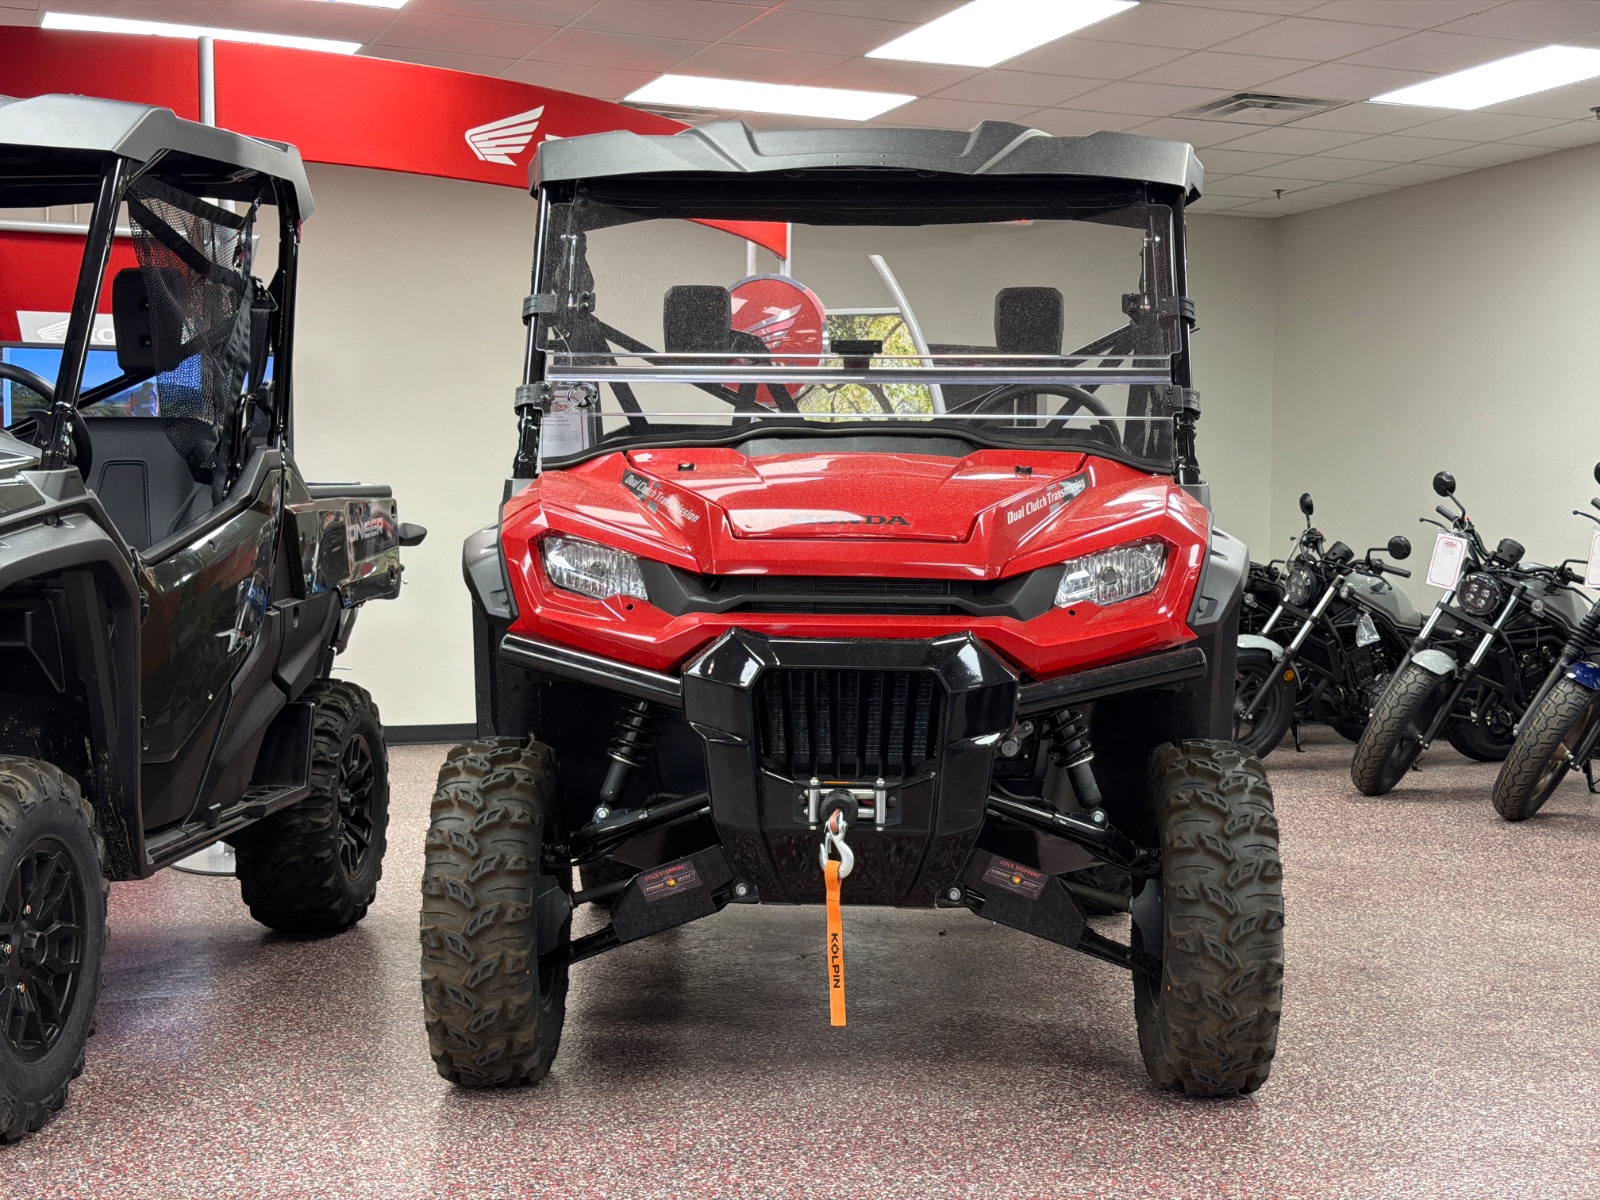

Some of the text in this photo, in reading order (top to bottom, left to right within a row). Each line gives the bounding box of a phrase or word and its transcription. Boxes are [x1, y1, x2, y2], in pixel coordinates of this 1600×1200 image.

[624, 474, 700, 523] Dual Clutch Transmission
[1007, 479, 1086, 525] Dual Clutch Transmission
[349, 516, 384, 543] ONEER
[644, 864, 686, 882] STICK STOPPERS
[1000, 860, 1015, 869] STICK
[1015, 865, 1041, 879] STOPPERS
[831, 933, 841, 989] KOLPIN
